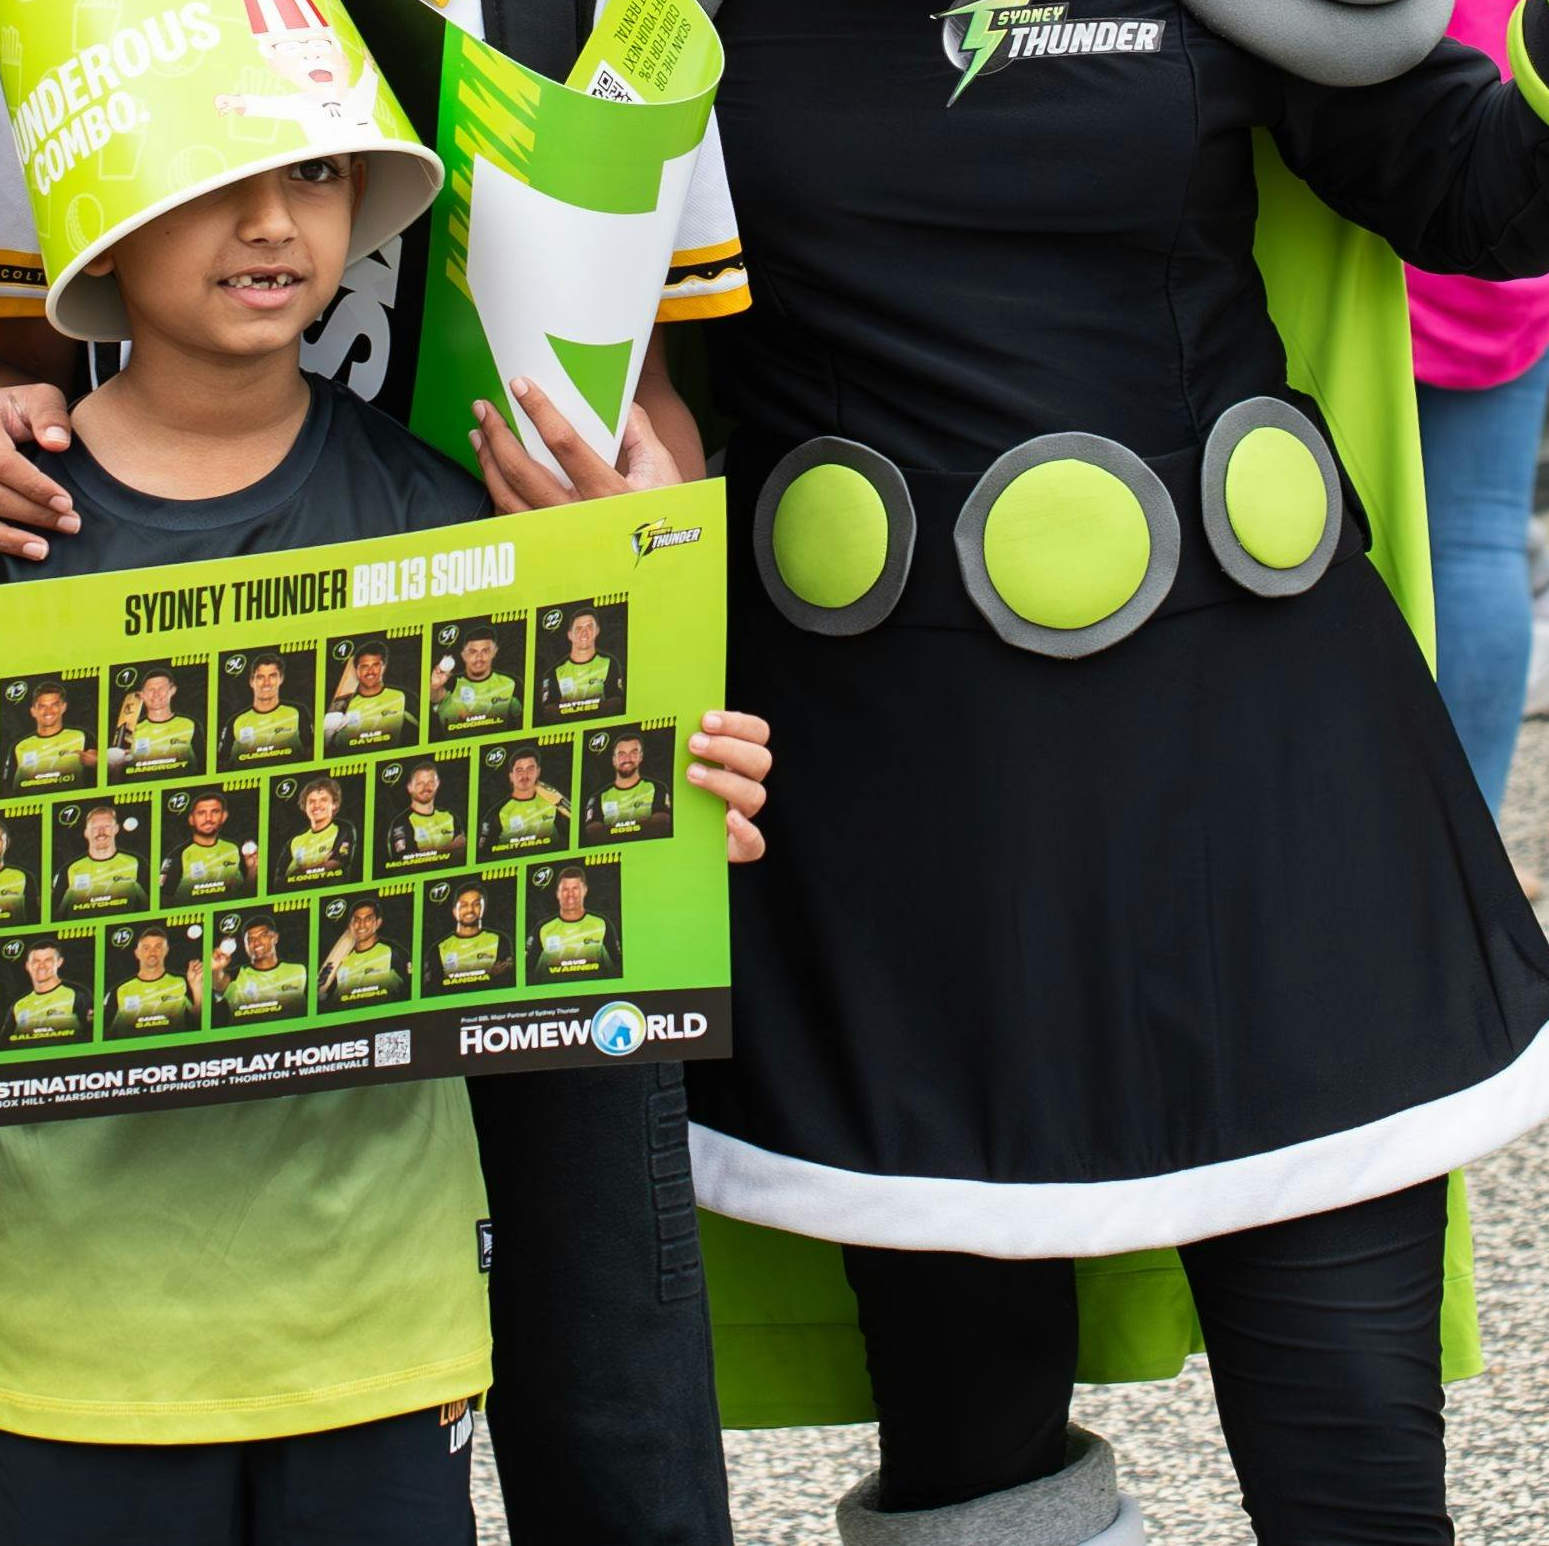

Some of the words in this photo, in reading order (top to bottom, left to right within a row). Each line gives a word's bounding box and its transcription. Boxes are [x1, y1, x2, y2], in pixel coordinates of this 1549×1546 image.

[613, 0, 642, 44] RENTAL
[636, 12, 659, 45] YOUR
[659, 4, 680, 39] CODE
[997, 5, 1065, 26] SYDNEY
[649, 33, 668, 61] FOR
[671, 18, 692, 53] SCAN
[1008, 21, 1159, 58] THUNDER
[622, 44, 644, 75] NEXT
[639, 55, 657, 83] 15%
[664, 50, 679, 77] THE
[12, 2, 221, 168] UNDEROUS
[34, 90, 151, 197] COMBO.
[652, 529, 701, 549] THUNDER
[124, 583, 226, 637] SYDNEY
[232, 568, 348, 620] THUNDER
[352, 555, 427, 608] BBL13
[431, 541, 515, 597] SQUAD
[349, 733, 391, 746] DAVIES
[287, 869, 343, 883] KONSTAS
[548, 962, 600, 975] WARNER
[128, 1064, 178, 1087] FOR
[182, 1052, 281, 1081] DISPLAY
[284, 1039, 370, 1068] HOMES
[21, 1096, 46, 1107] HILL
[54, 1089, 110, 1103] MARSDEN
[111, 1086, 141, 1097] PARK
[150, 1078, 220, 1093] LEPPINGTON
[229, 1069, 290, 1085] THORNTON
[298, 1057, 370, 1077] WARNERVALE
